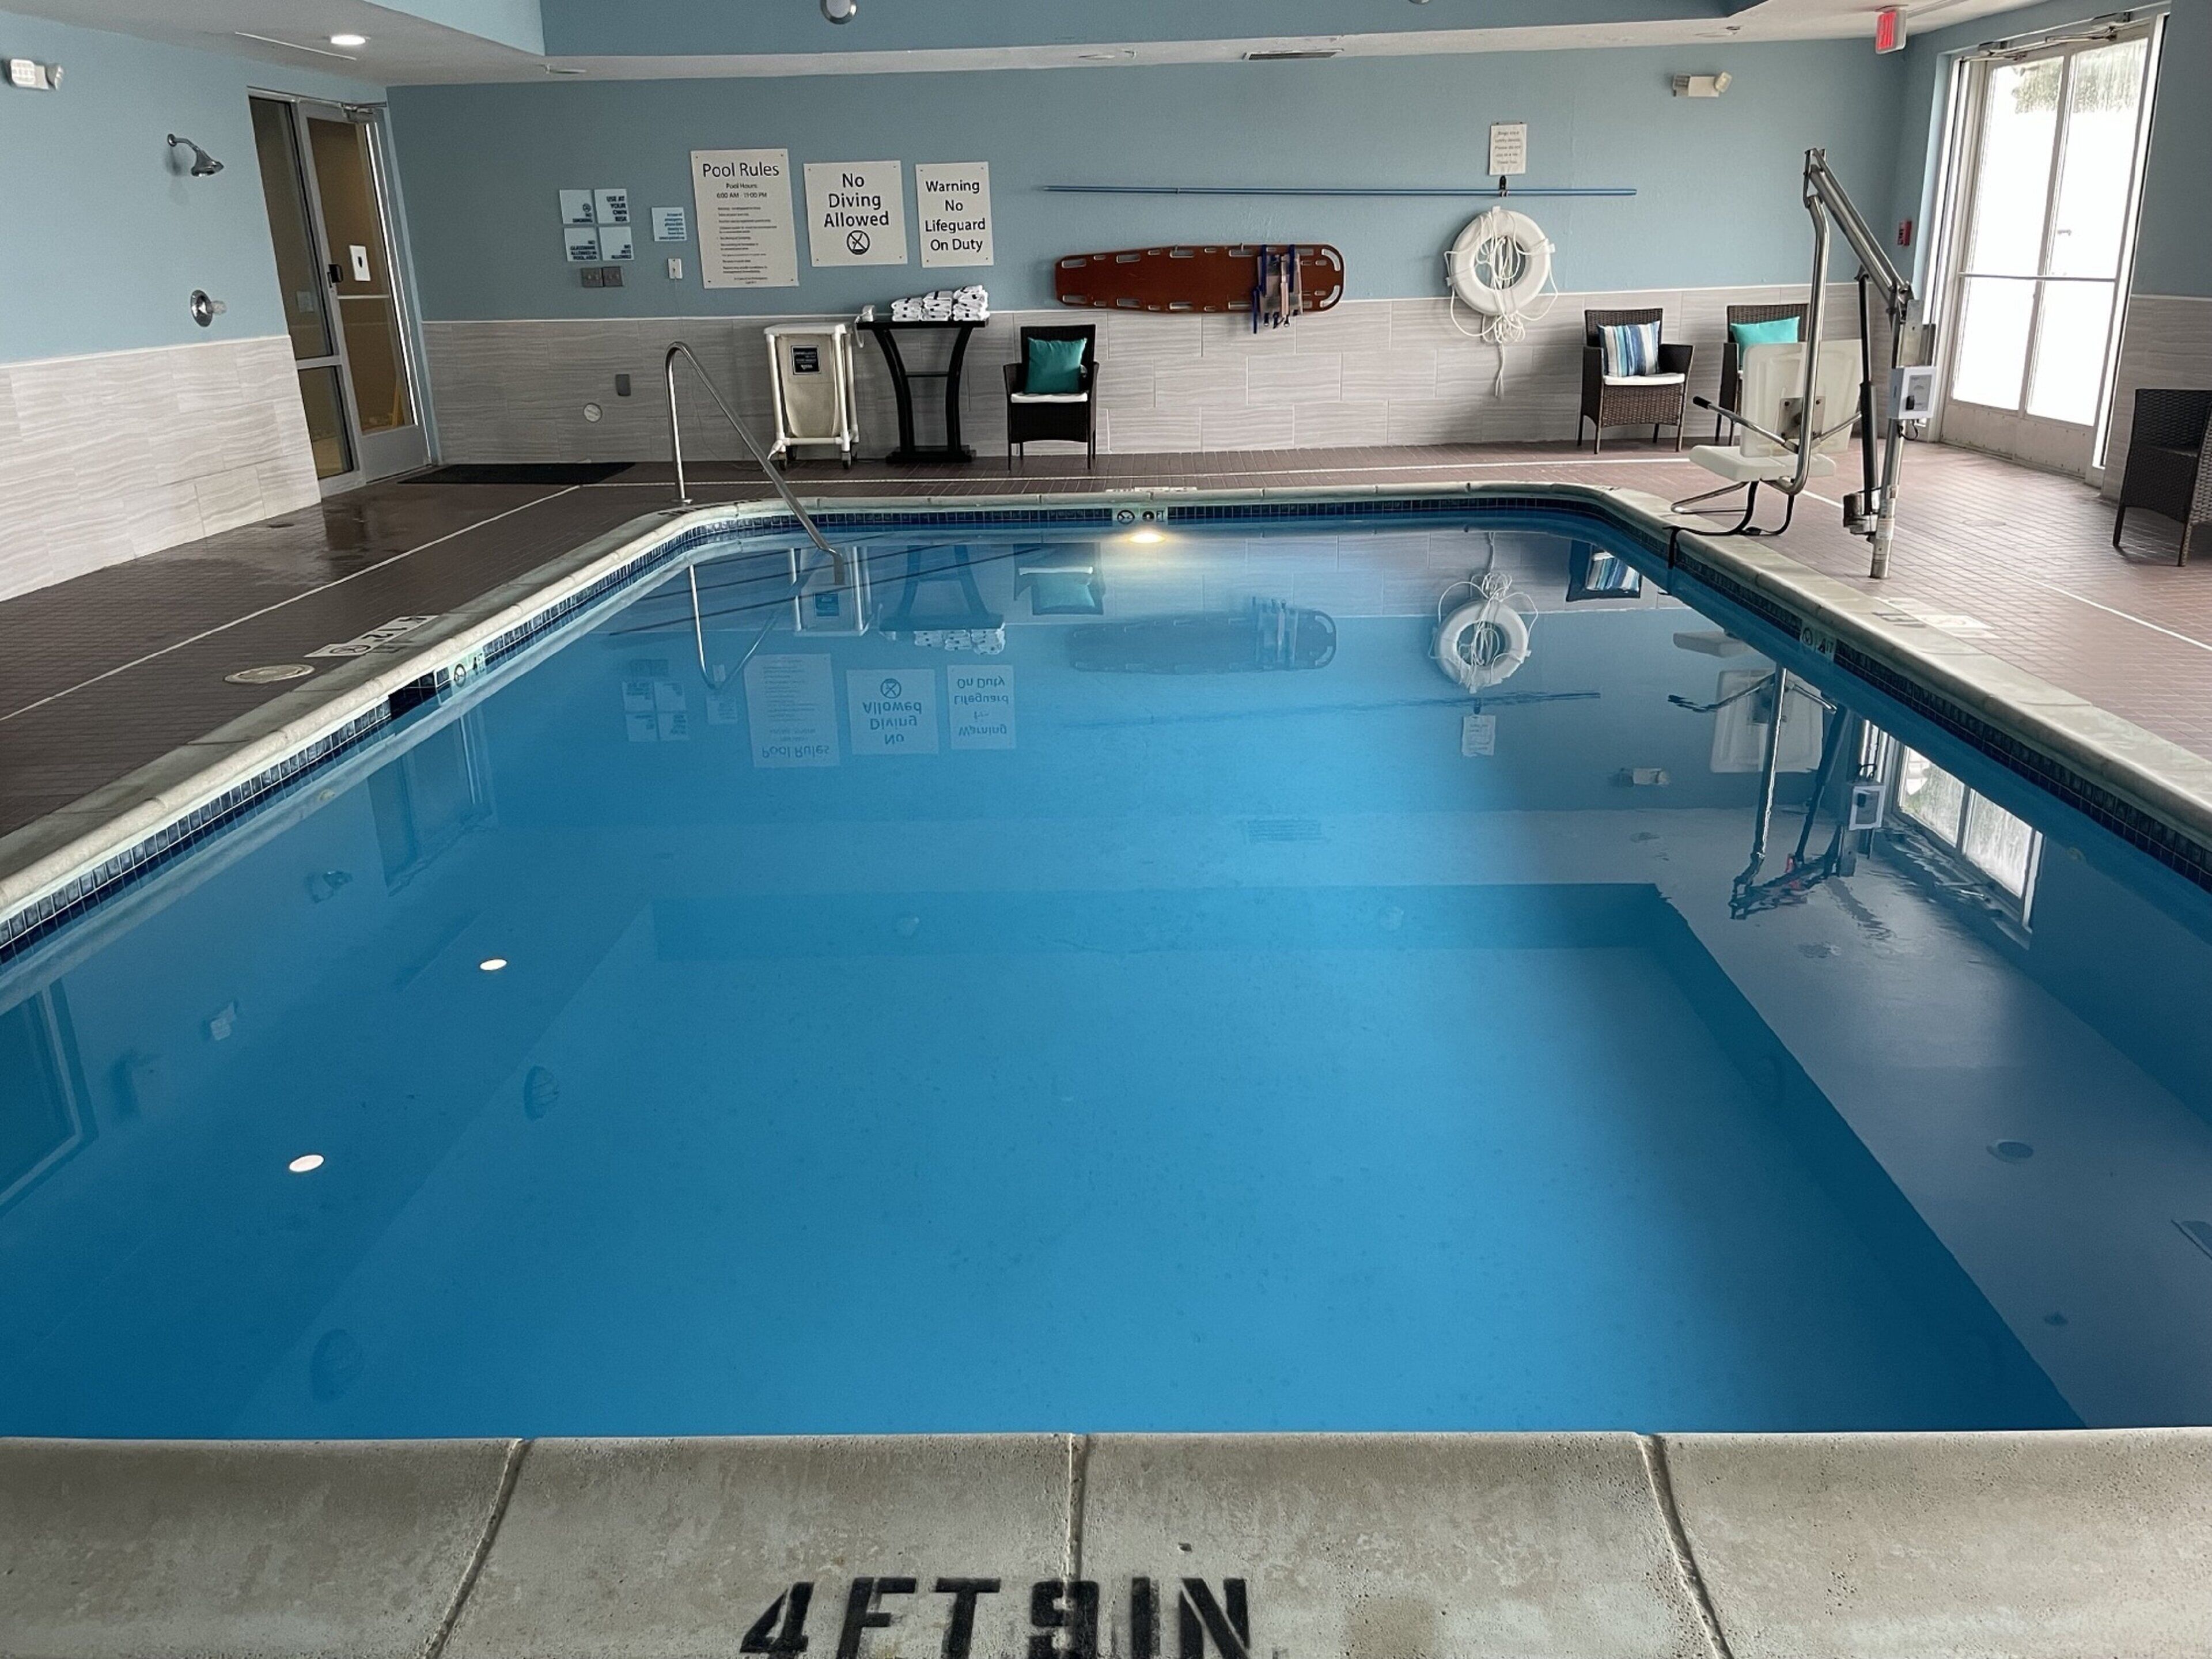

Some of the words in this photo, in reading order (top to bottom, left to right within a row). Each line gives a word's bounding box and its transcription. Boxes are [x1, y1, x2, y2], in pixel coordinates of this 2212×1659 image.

[702, 162, 735, 177] Pool
[740, 161, 779, 176] Rules
[842, 173, 865, 188] No
[925, 180, 980, 194] Warning
[828, 192, 881, 210] Diving
[945, 199, 963, 211] No
[824, 211, 889, 228] Allowed
[925, 218, 986, 234] Lifeguard
[930, 239, 948, 251] On
[952, 238, 983, 252] Duty
